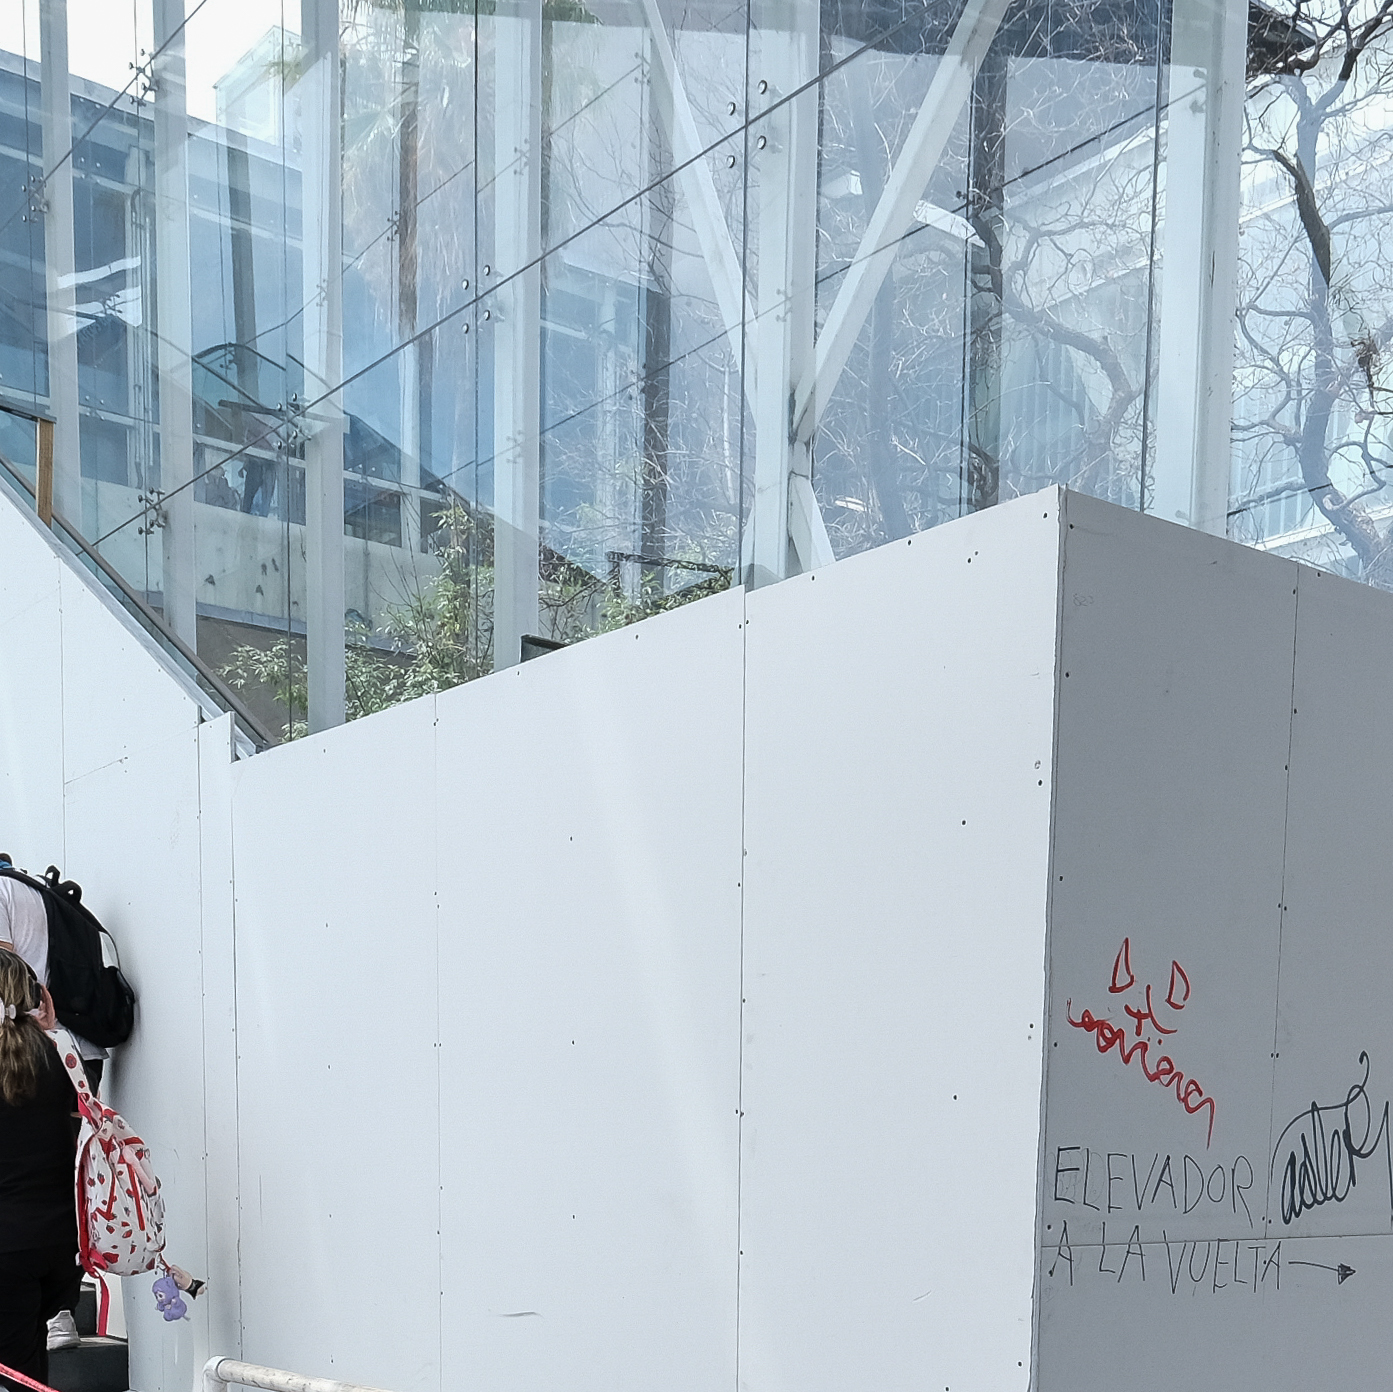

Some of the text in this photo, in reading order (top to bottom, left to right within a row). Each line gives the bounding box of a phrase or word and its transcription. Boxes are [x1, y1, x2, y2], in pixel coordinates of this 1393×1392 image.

[1054, 1146, 1253, 1228] ELEVADOR
[1049, 1219, 1281, 1294] A LA VUELTA
